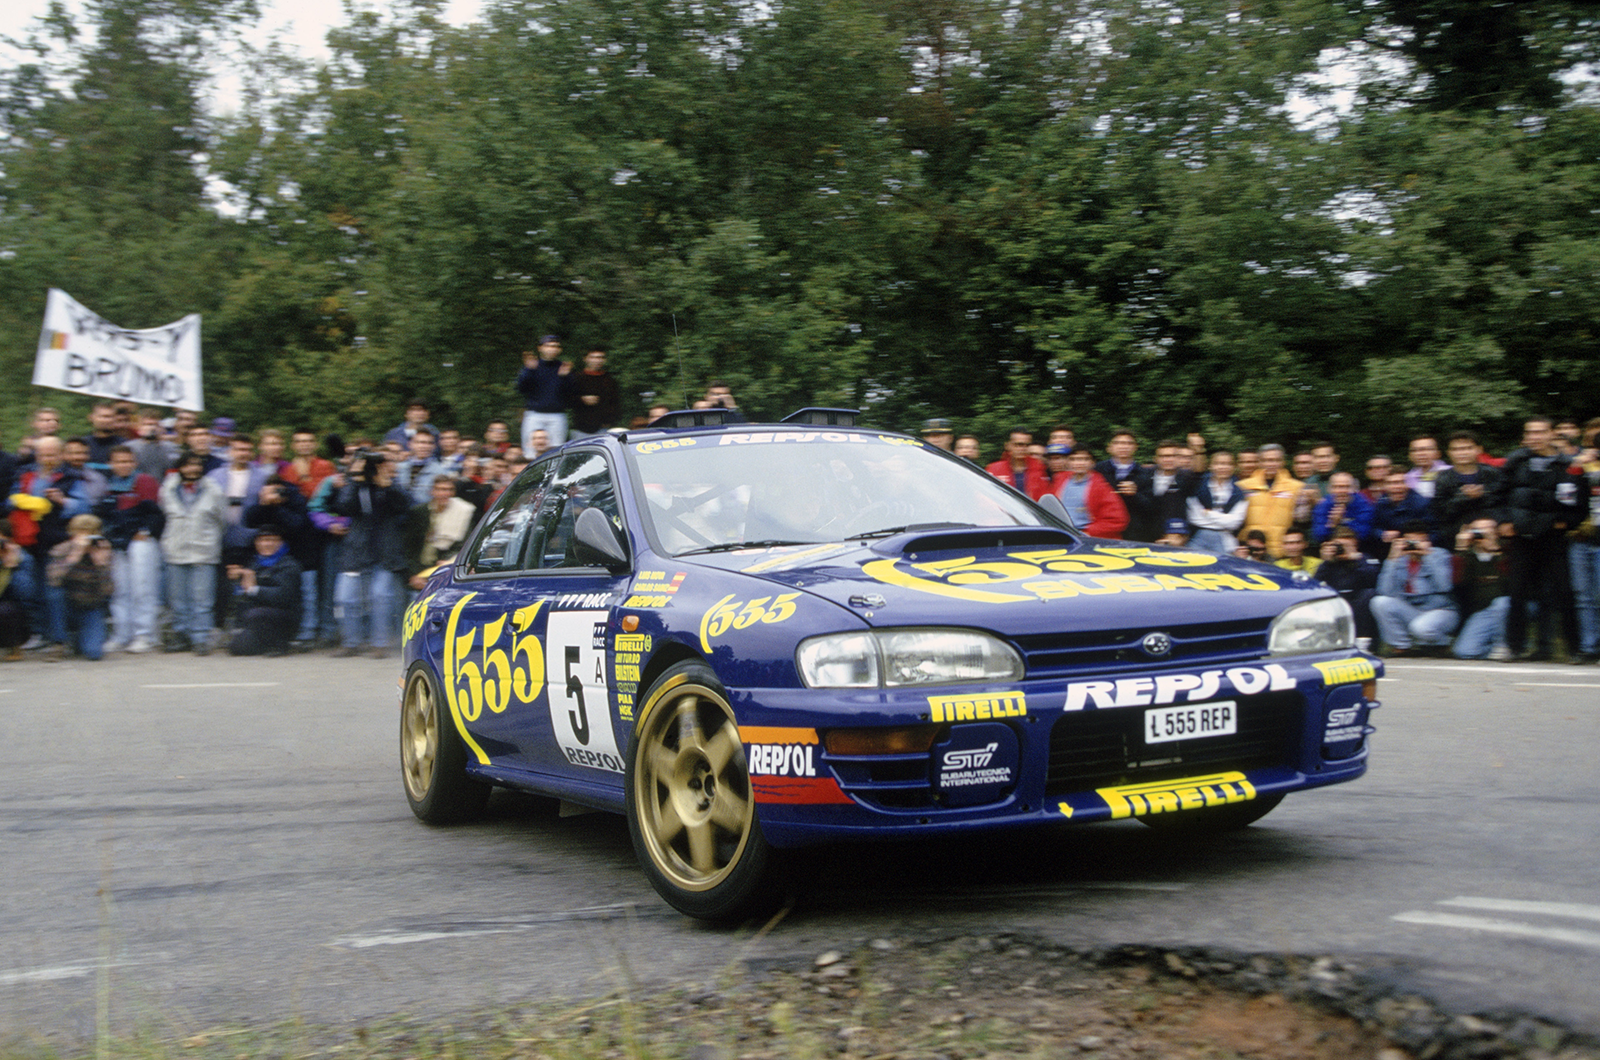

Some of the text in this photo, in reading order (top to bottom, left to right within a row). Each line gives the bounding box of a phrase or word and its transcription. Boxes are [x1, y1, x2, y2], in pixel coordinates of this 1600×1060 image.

[63, 353, 185, 403] BRUNO
[719, 433, 867, 446] REPSOL
[911, 548, 1218, 584] 555
[581, 592, 612, 608] RACC
[1022, 574, 1281, 599] SUBARU
[709, 592, 803, 637] 555
[615, 634, 645, 652] PIRELLI
[457, 598, 545, 722] 555
[595, 656, 604, 684] A
[1312, 657, 1376, 685] PIRELLI
[564, 646, 590, 745] 5
[1063, 664, 1297, 711] REPSOL
[927, 691, 1027, 722] PIRELLI
[1165, 714, 1196, 735] 555
[1201, 707, 1231, 731] REP
[565, 747, 625, 773] REPSOL
[750, 744, 816, 776] REPSOL
[940, 767, 1011, 780] SUBARU TECNICA
[940, 775, 1010, 787] INTERNATIONAL
[1095, 771, 1257, 819] PIRELLI
